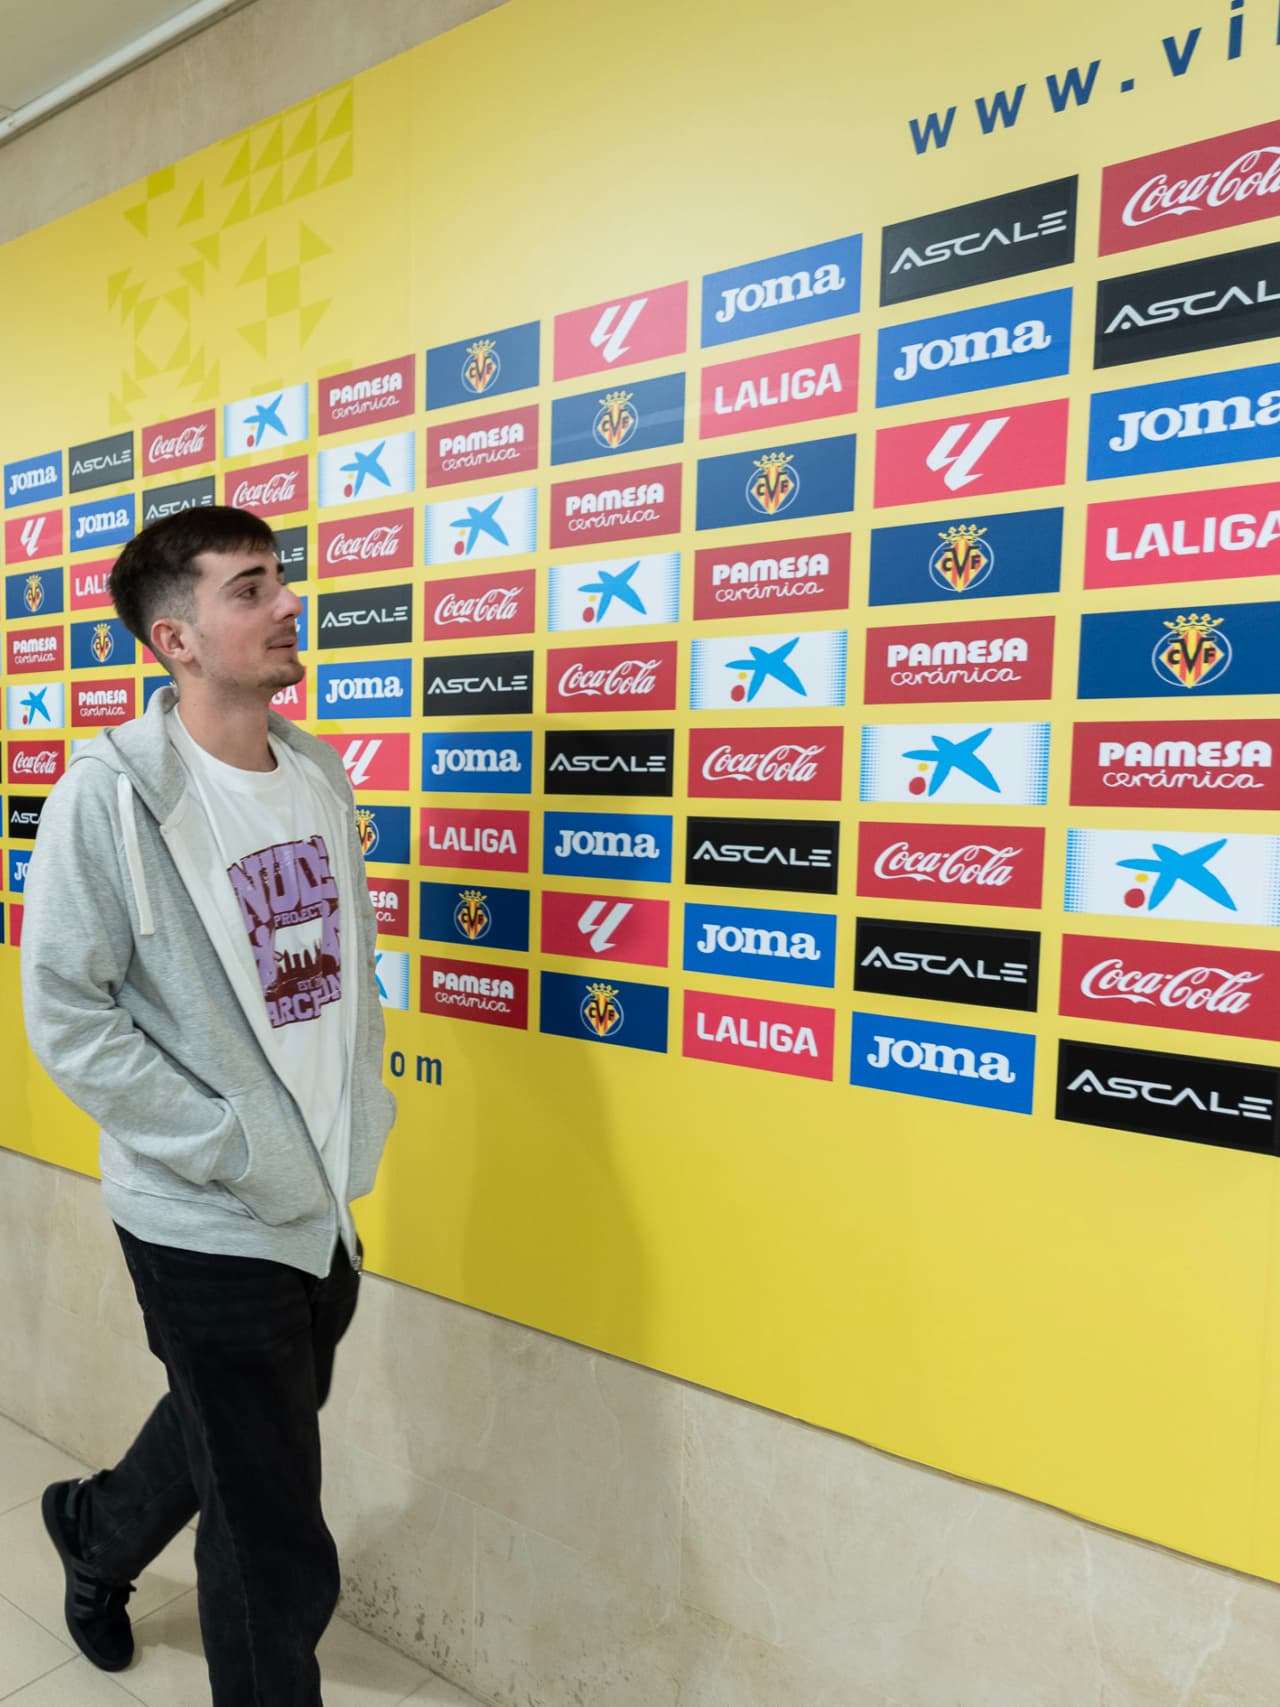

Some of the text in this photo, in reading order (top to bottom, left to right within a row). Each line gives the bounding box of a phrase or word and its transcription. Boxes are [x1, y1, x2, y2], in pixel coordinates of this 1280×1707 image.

[908, 0, 1280, 155] www.vi
[889, 209, 1067, 274] ASCALE
[1104, 280, 1280, 333] ASCAL
[329, 372, 403, 406] PAMESA
[714, 363, 842, 414] LALIGA
[331, 394, 399, 420] cerámica
[149, 425, 208, 463] Coca-Cola
[439, 423, 524, 456] PAMESA
[72, 450, 131, 475] ASCALE
[441, 447, 519, 472] cerámica
[232, 471, 298, 510] Coca-Cola
[565, 482, 664, 516] PAMESA
[568, 509, 660, 531] cerámica
[327, 525, 402, 563] Coca-Cola
[1106, 510, 1280, 561] LALIGA
[712, 553, 829, 586] PAMESA
[75, 574, 112, 596] LALI
[715, 582, 824, 603] cerámica
[321, 606, 408, 628] ASCALE
[434, 587, 522, 625] Coca-Cola
[13, 637, 57, 654] PAMESA
[887, 637, 1029, 668] PAMESA
[428, 675, 527, 694] ASCALE
[558, 660, 661, 696] Coca-Cola
[891, 667, 1021, 687] cerámica
[78, 689, 127, 705] PAMESA
[13, 751, 58, 775] Coca-Cola
[550, 753, 666, 772] ASCALE
[702, 745, 824, 781] Coca-Cola
[1098, 740, 1272, 767] PAMESA
[1103, 768, 1265, 789] cerámica
[10, 810, 40, 823] ASC
[429, 826, 516, 853] LALIGA
[693, 841, 831, 867] ASCALE
[874, 842, 1022, 886] Coca-Cola
[370, 890, 399, 909] ESA
[861, 946, 1027, 983] ASCALE
[432, 971, 514, 1000] PAMESA
[1081, 959, 1262, 1013] Coca-Cola
[435, 991, 510, 1013] cerámica
[697, 1013, 818, 1056] LALIGA
[1067, 1070, 1272, 1120] ASCALE
